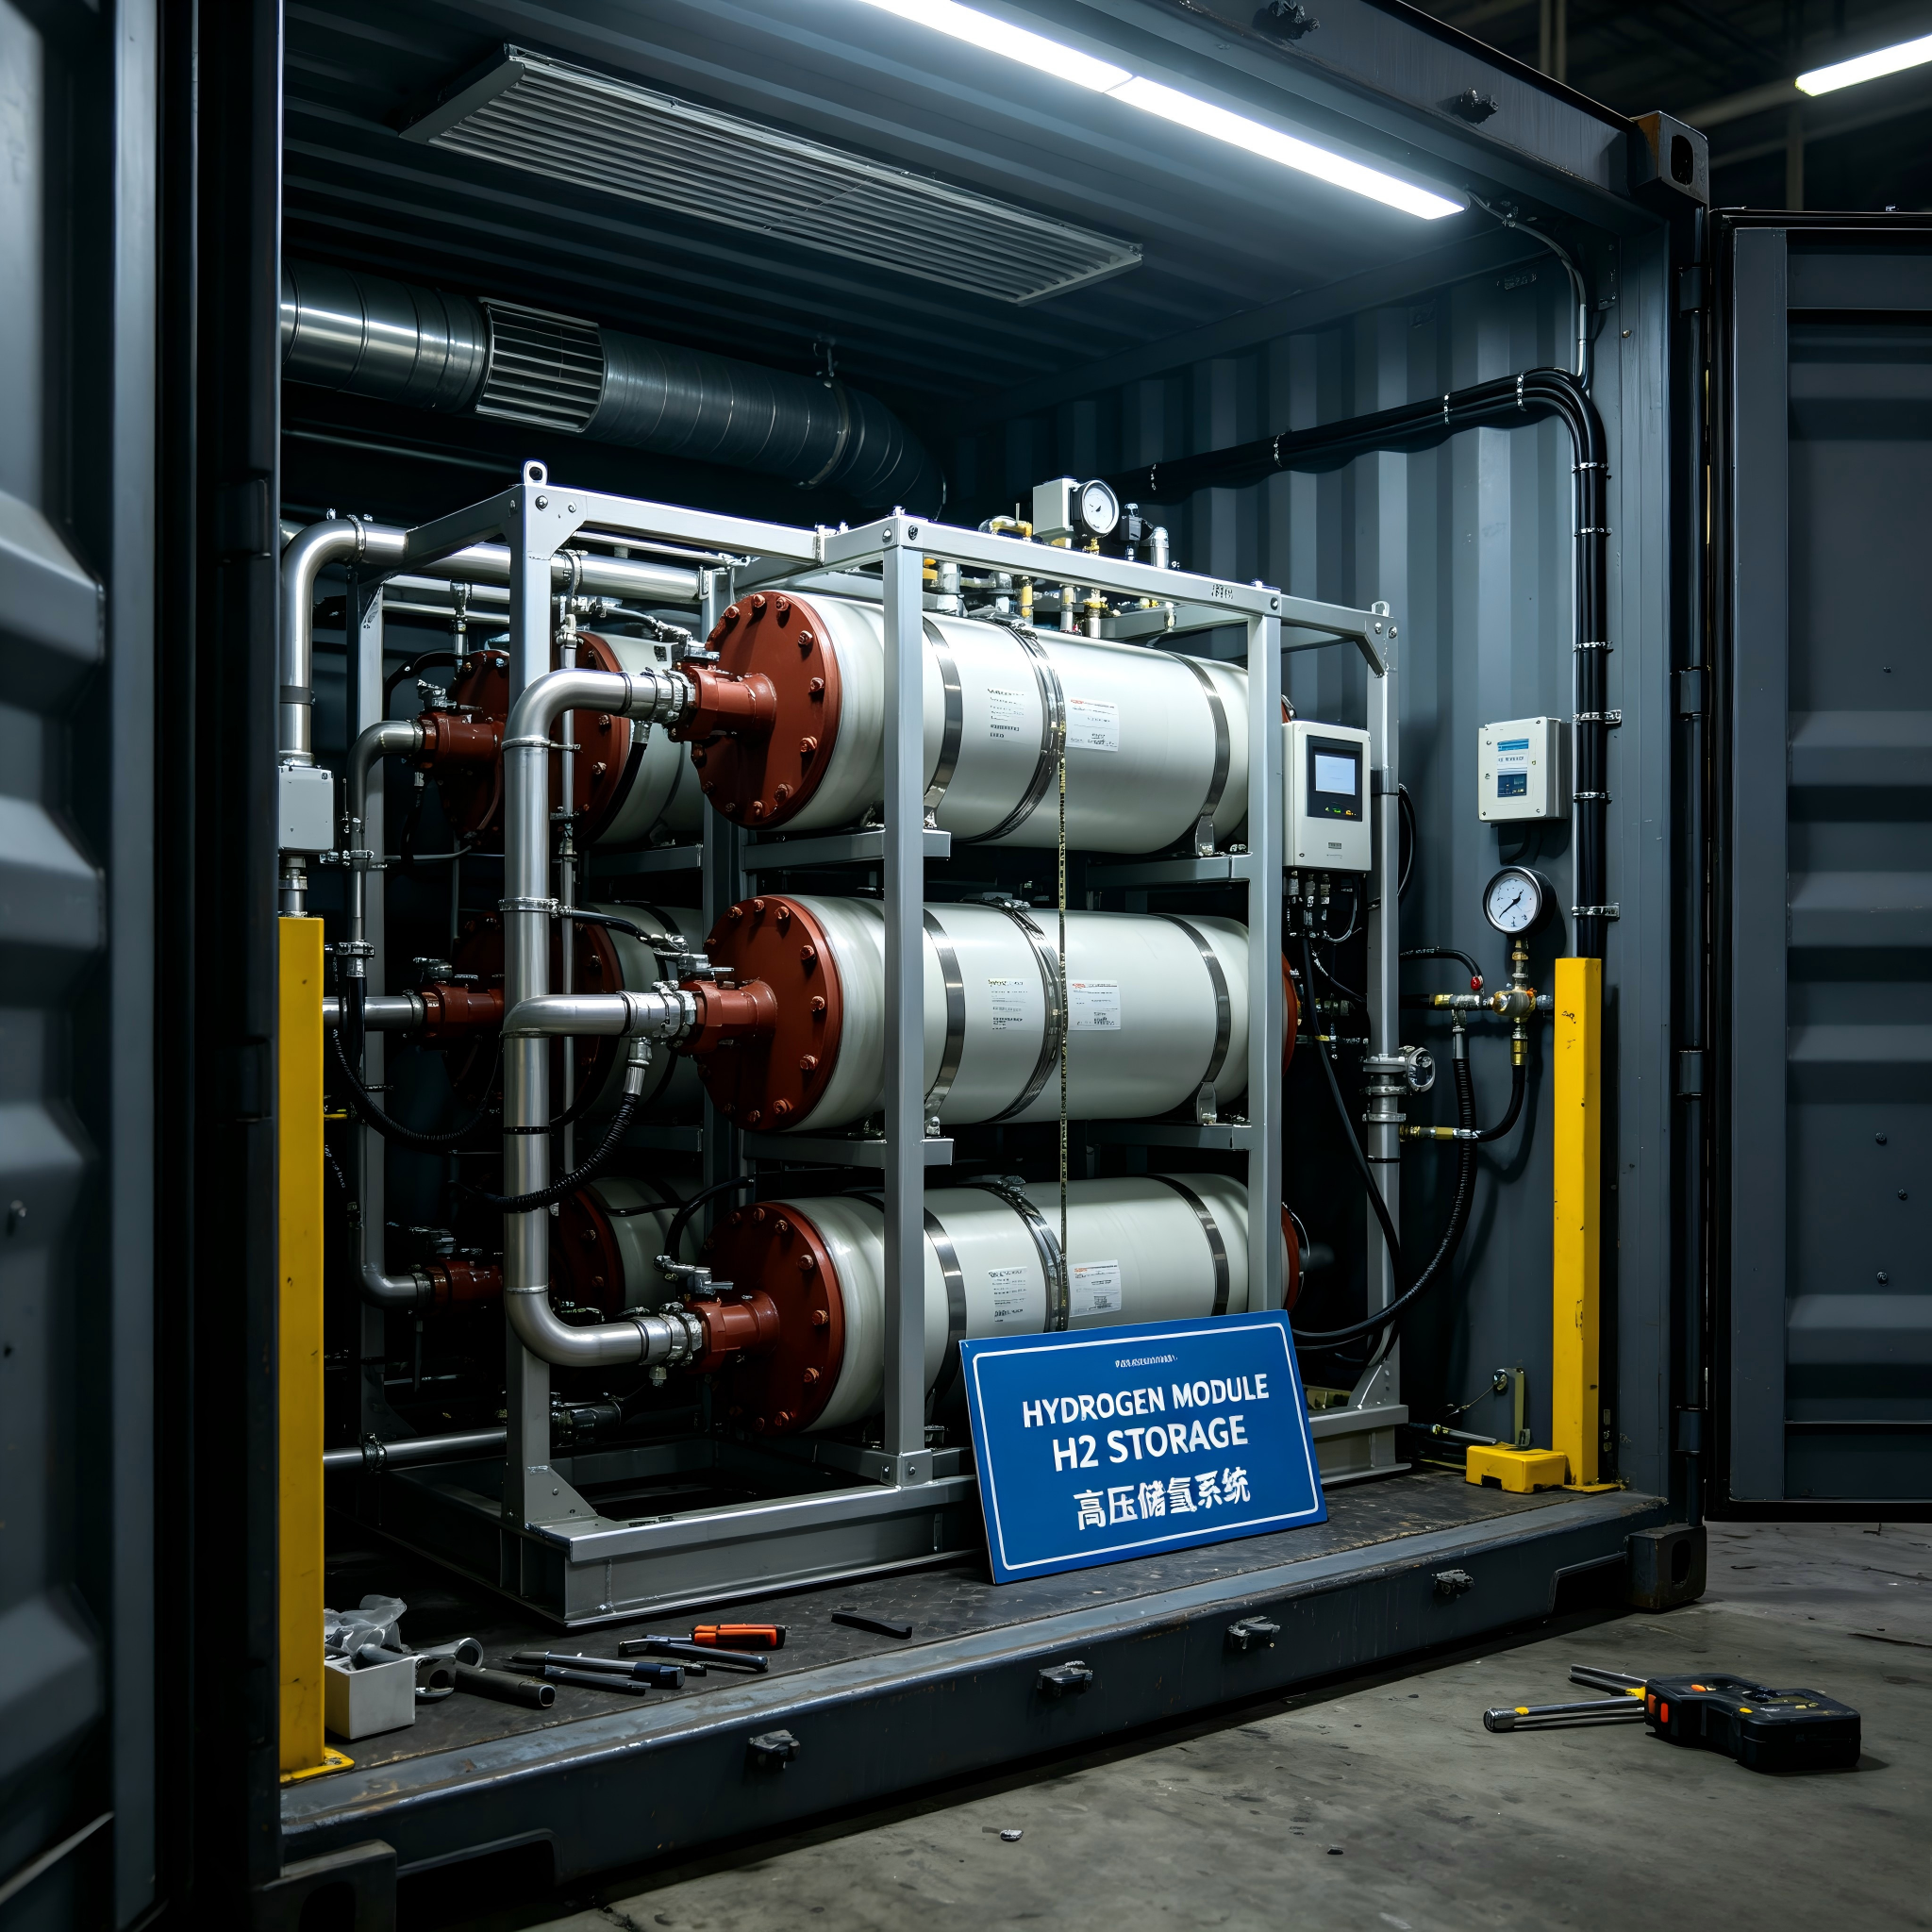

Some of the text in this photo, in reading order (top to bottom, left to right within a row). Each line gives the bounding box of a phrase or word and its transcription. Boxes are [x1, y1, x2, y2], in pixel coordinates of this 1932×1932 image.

[1023, 1374, 1270, 1428] HYDROGEN MODULE
[1053, 1414, 1249, 1473] H2 STORAGE
